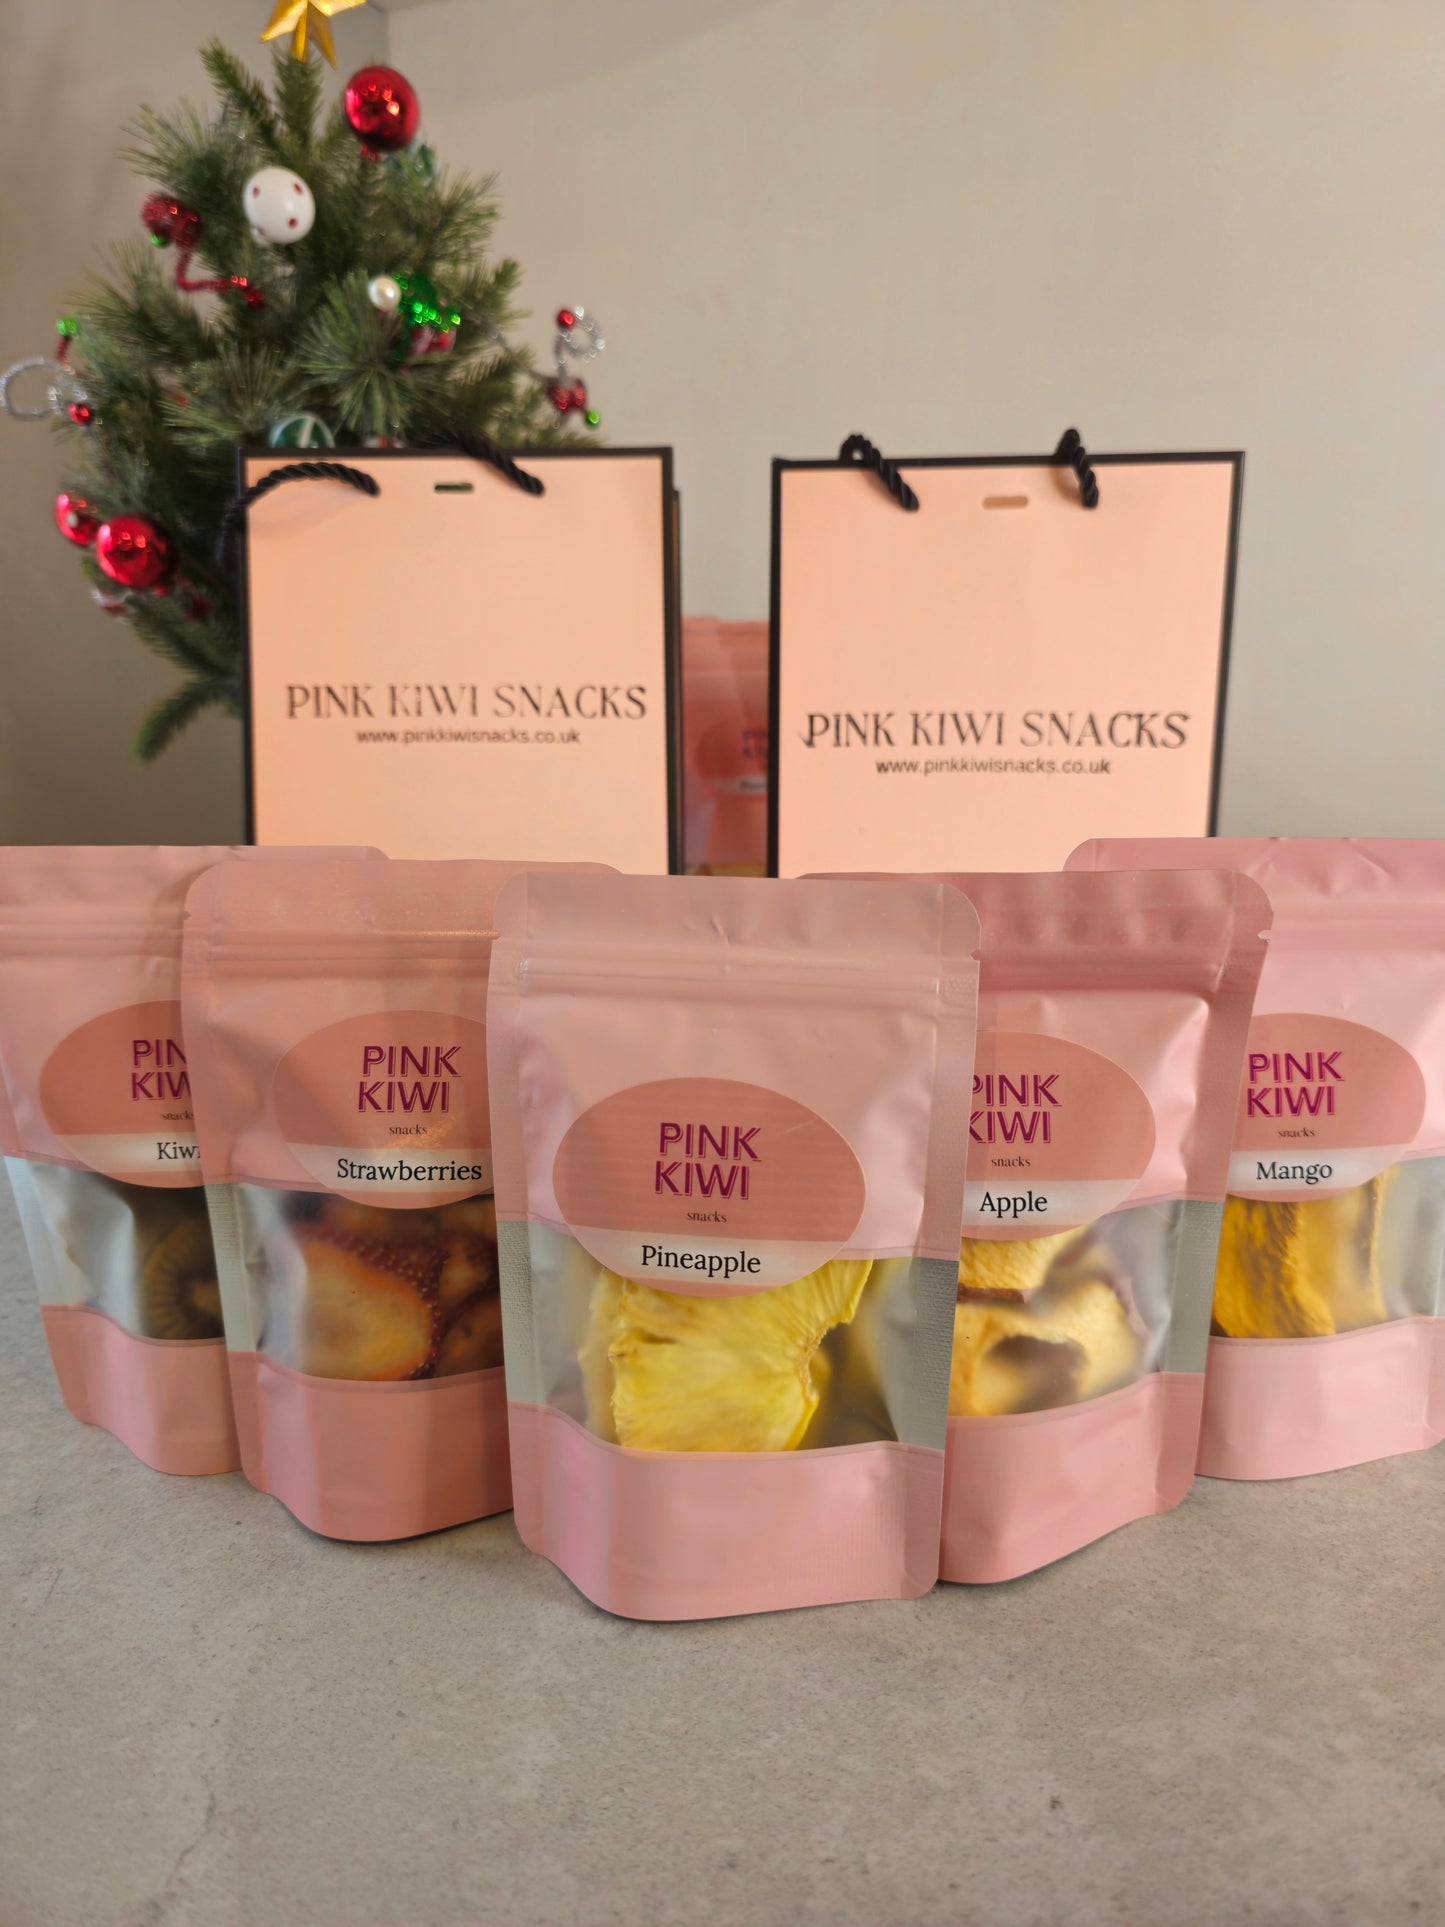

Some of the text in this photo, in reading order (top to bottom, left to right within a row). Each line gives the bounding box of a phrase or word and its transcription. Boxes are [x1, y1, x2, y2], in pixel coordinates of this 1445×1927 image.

[285, 683, 648, 720] PINK KIWI SNACKS
[356, 729, 582, 746] www.pinkkiwisnacks.co.uk
[802, 711, 896, 749] PINK
[910, 711, 1006, 748] KIWI
[1020, 710, 1190, 749] SNACKS
[875, 757, 1113, 776] www.pinkkiwisnacks.co.uk
[132, 1039, 187, 1069] PIN
[362, 1045, 462, 1078] PINK
[1248, 1051, 1345, 1084] PINK
[131, 1071, 192, 1101] KIW
[357, 1081, 450, 1113] KIWI
[1247, 1085, 1336, 1118] KIWI
[389, 1123, 428, 1136] snacks
[658, 1122, 762, 1163] PINK
[1278, 1127, 1316, 1138] snacks
[337, 1158, 483, 1181] Strawberries
[991, 1155, 1032, 1168] snacks
[1255, 1161, 1333, 1186] Mango
[654, 1160, 751, 1201] KIWI
[686, 1210, 728, 1224] snacks
[979, 1190, 1049, 1219] Apple
[641, 1244, 762, 1280] Pineapple
